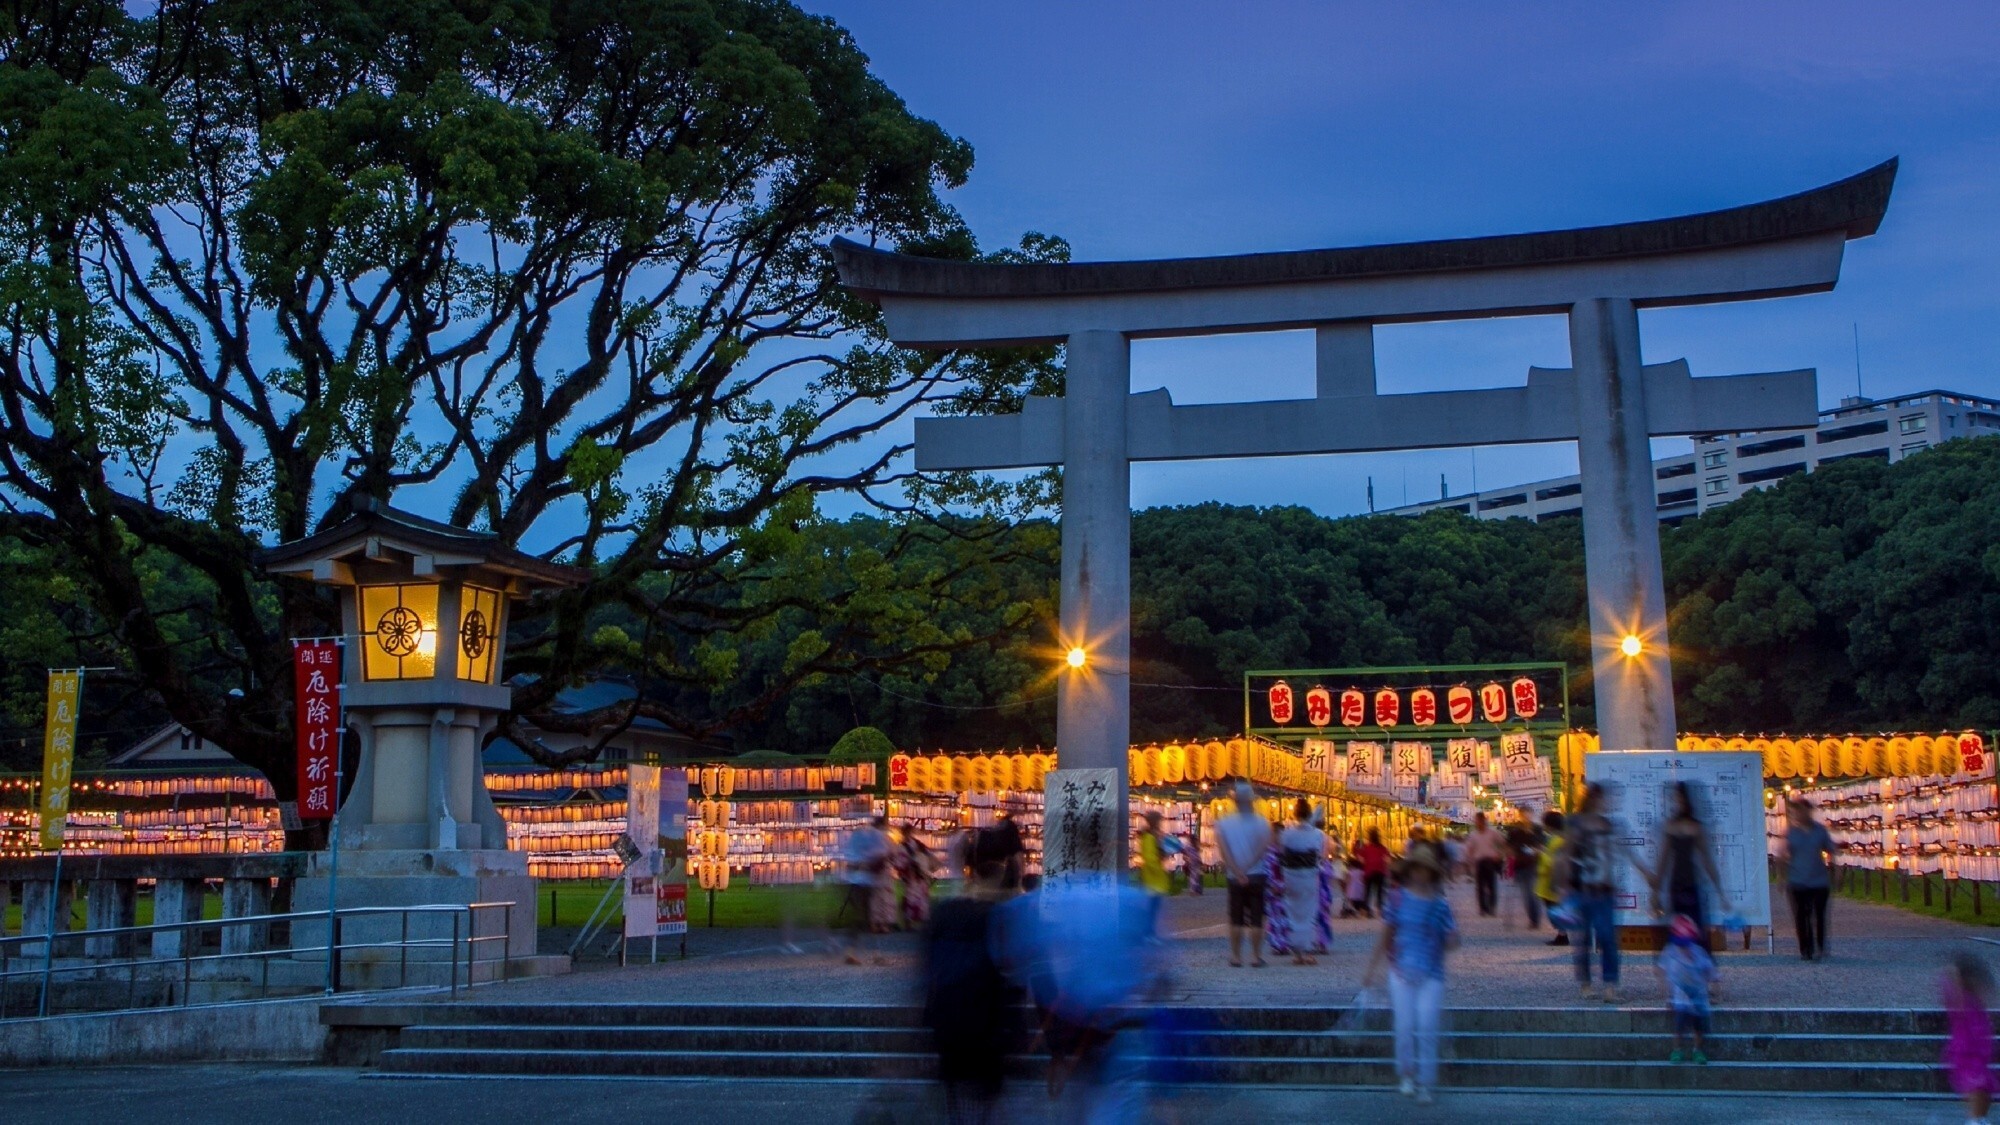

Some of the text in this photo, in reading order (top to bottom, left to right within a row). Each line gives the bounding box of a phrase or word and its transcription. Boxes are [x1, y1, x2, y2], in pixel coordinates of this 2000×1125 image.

[305, 669, 331, 811] 厄除け祈願
[1305, 740, 1531, 774] 祈震災復興
